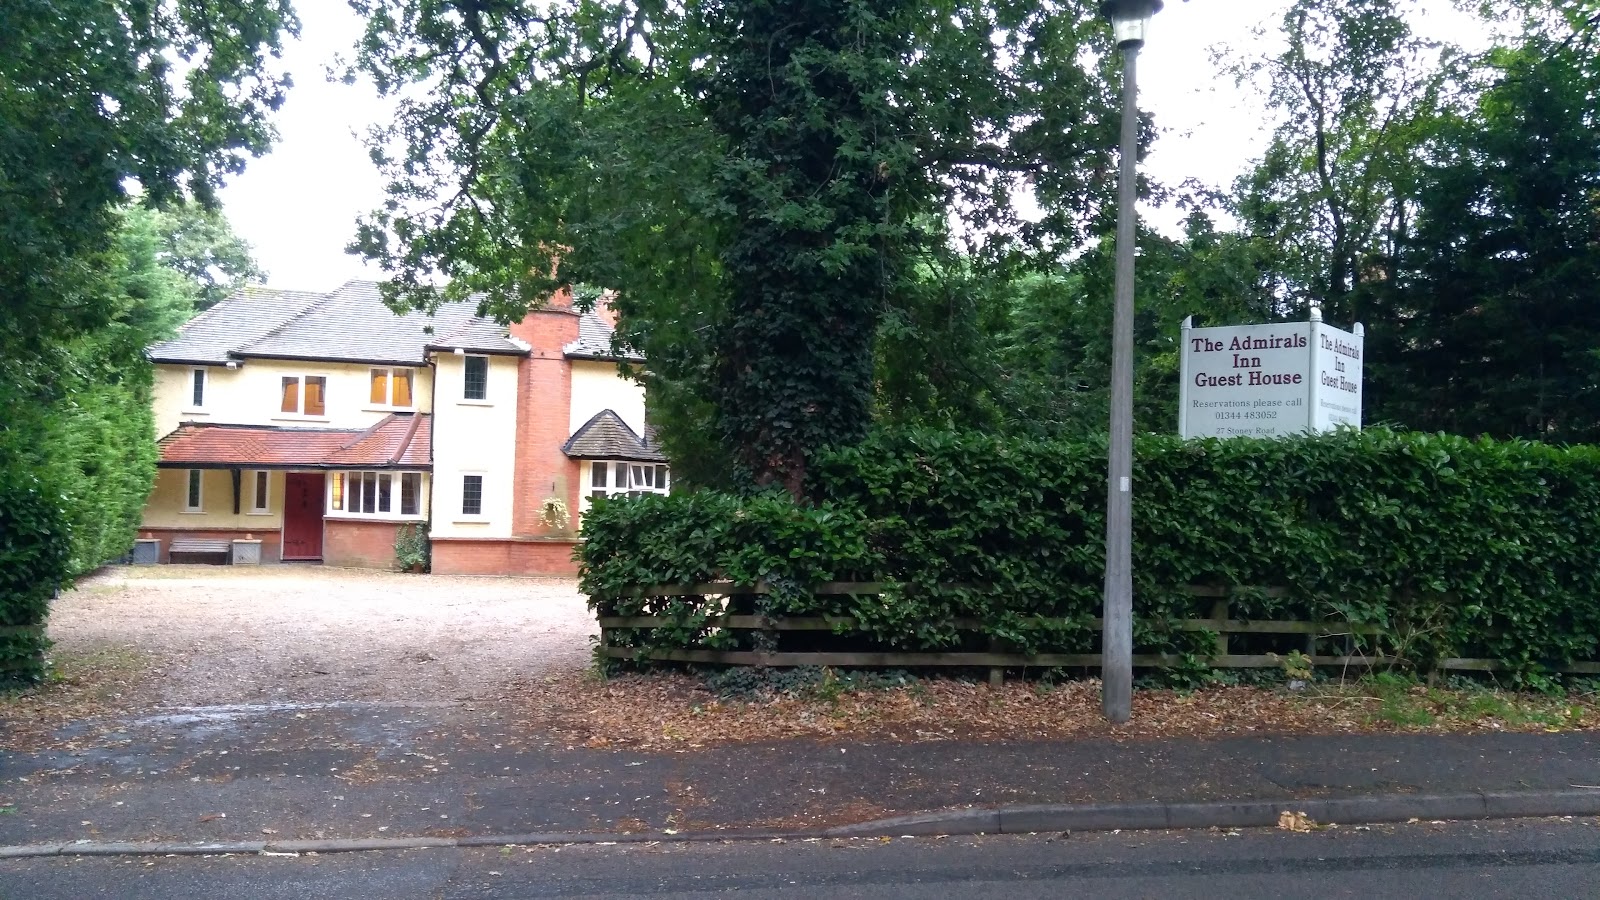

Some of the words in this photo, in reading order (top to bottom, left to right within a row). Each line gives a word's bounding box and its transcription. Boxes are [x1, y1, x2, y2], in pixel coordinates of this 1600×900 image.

[1191, 338, 1224, 352] The
[1228, 333, 1307, 351] Admirals
[1320, 333, 1333, 351] The
[1333, 338, 1360, 360] Admirals
[1232, 354, 1261, 368] Inn
[1335, 356, 1345, 373] Inn
[1195, 372, 1243, 387] Guest
[1248, 371, 1302, 386] House
[1321, 370, 1339, 389] Guest
[1340, 375, 1357, 394] House
[1192, 399, 1251, 408] Reservations
[1253, 398, 1283, 409] please
[1285, 398, 1302, 407] call
[1215, 411, 1241, 420] 01344
[1243, 411, 1277, 420] 483052
[1215, 427, 1225, 435] 27
[1227, 427, 1253, 436] Stoney
[1255, 427, 1275, 435] Road
